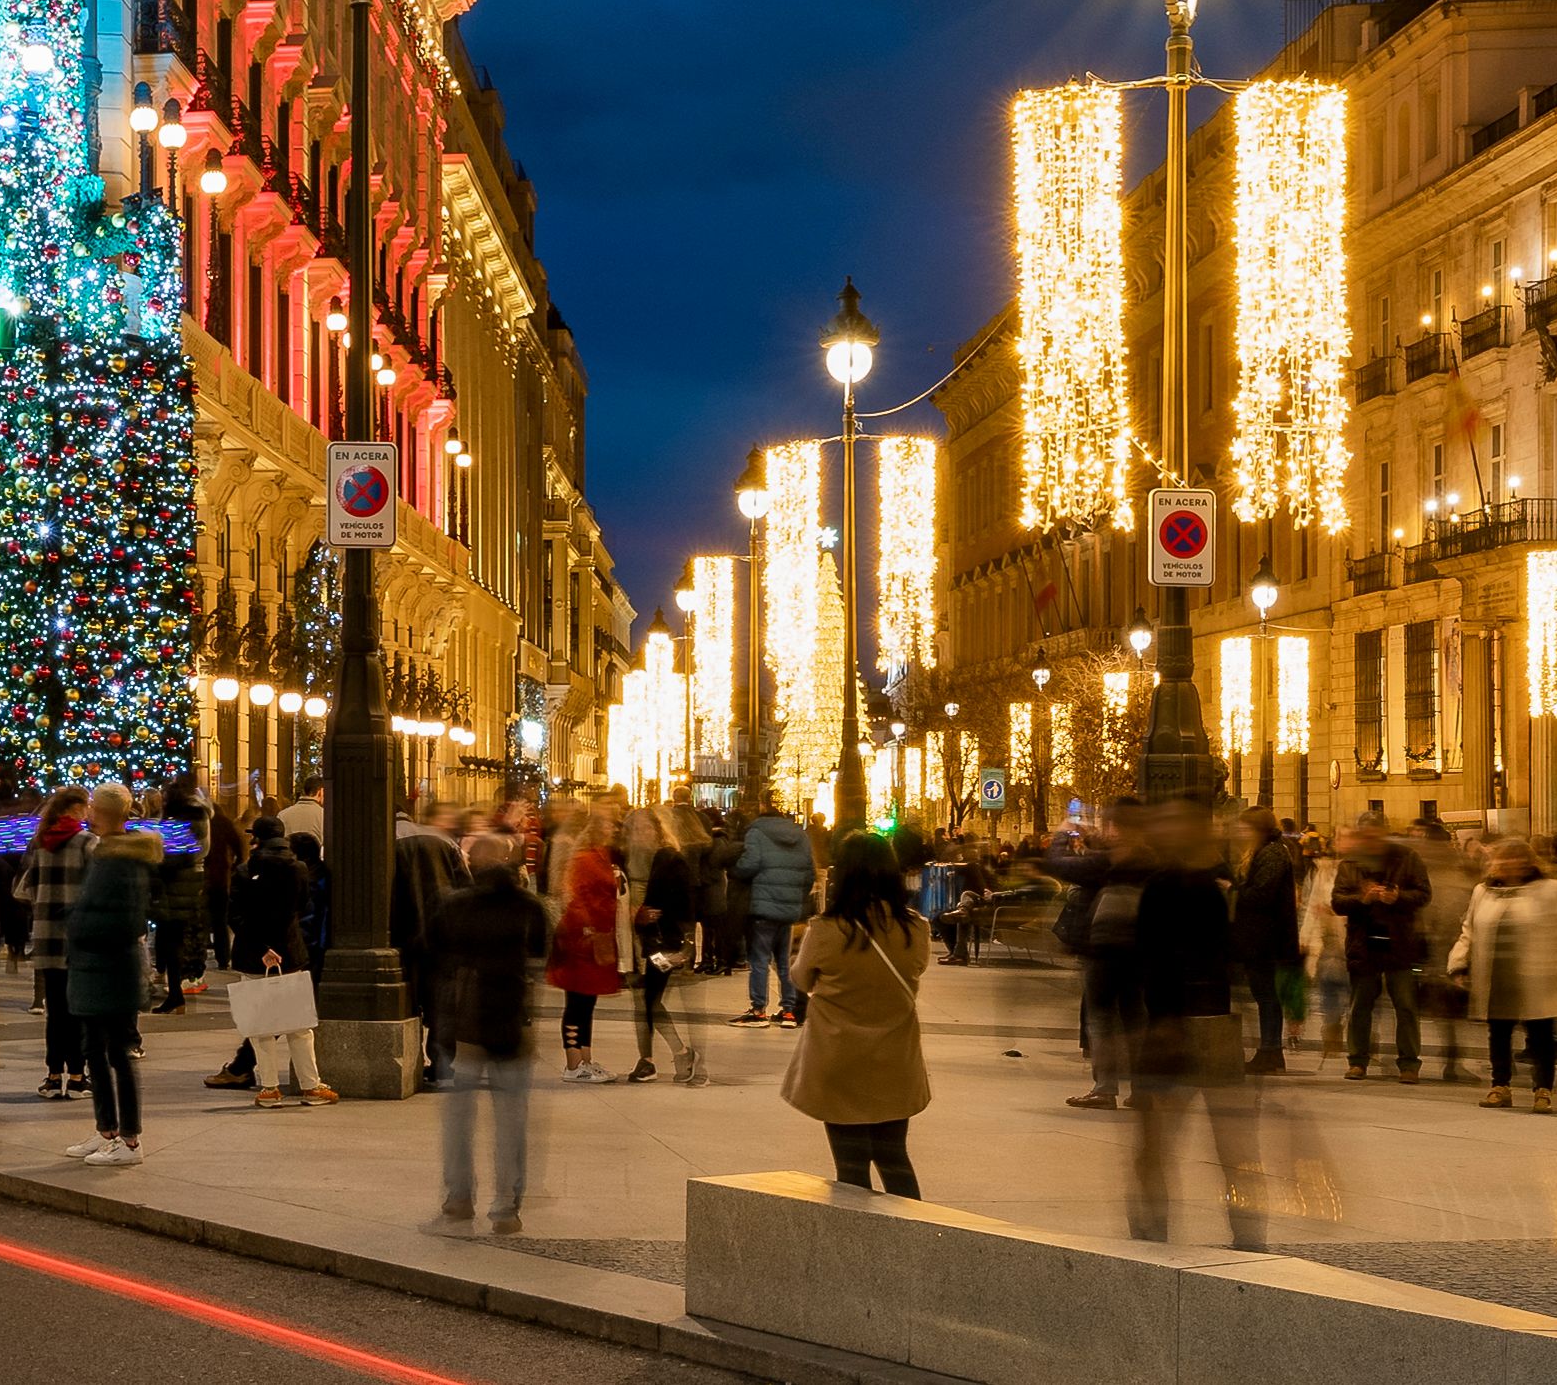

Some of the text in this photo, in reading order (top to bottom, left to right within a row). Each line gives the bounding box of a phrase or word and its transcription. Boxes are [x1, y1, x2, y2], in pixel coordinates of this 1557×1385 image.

[335, 451, 389, 461] EN ACERA
[1175, 498, 1208, 506] ACERA
[340, 521, 384, 530] VEHÍCULOS
[354, 531, 383, 539] MOTOR
[1162, 562, 1203, 570] VEHÍCULOS
